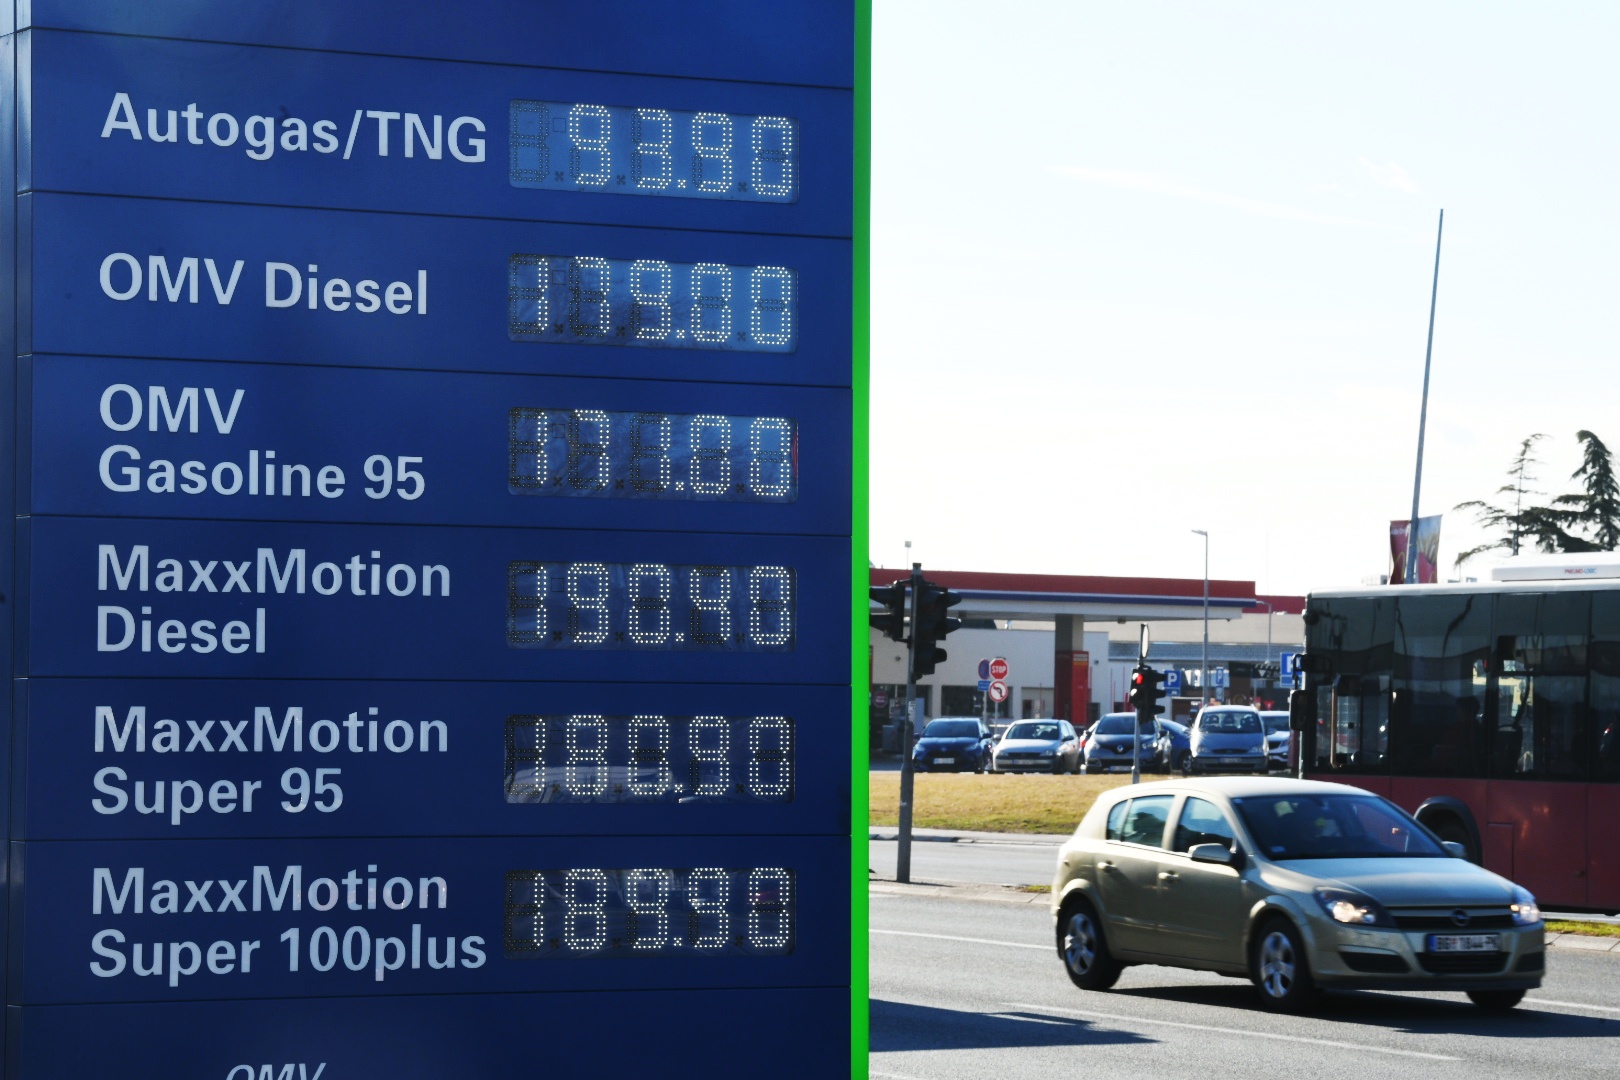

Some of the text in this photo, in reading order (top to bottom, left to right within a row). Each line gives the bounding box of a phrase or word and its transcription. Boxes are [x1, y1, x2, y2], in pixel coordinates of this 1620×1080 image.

[100, 92, 486, 163] Autogas/TNG
[569, 103, 793, 197] 93.90
[100, 252, 427, 316] OMV Diesel
[537, 256, 792, 346] 179.00
[99, 383, 245, 434] OMV
[99, 444, 425, 501] Gasoline 95
[537, 409, 792, 497] 171.00
[98, 544, 450, 597] MaxxMotion
[97, 605, 266, 654] Diesel
[536, 562, 791, 645] 190.40
[991, 665, 1007, 674] STOP
[1167, 672, 1178, 686] P
[94, 706, 448, 753] MaxxMotion
[535, 714, 791, 796] 180.90
[91, 766, 343, 826] Super 95
[92, 864, 447, 915] MaxxMotion
[533, 867, 790, 951] 189.90
[89, 923, 487, 987] Super 100plus
